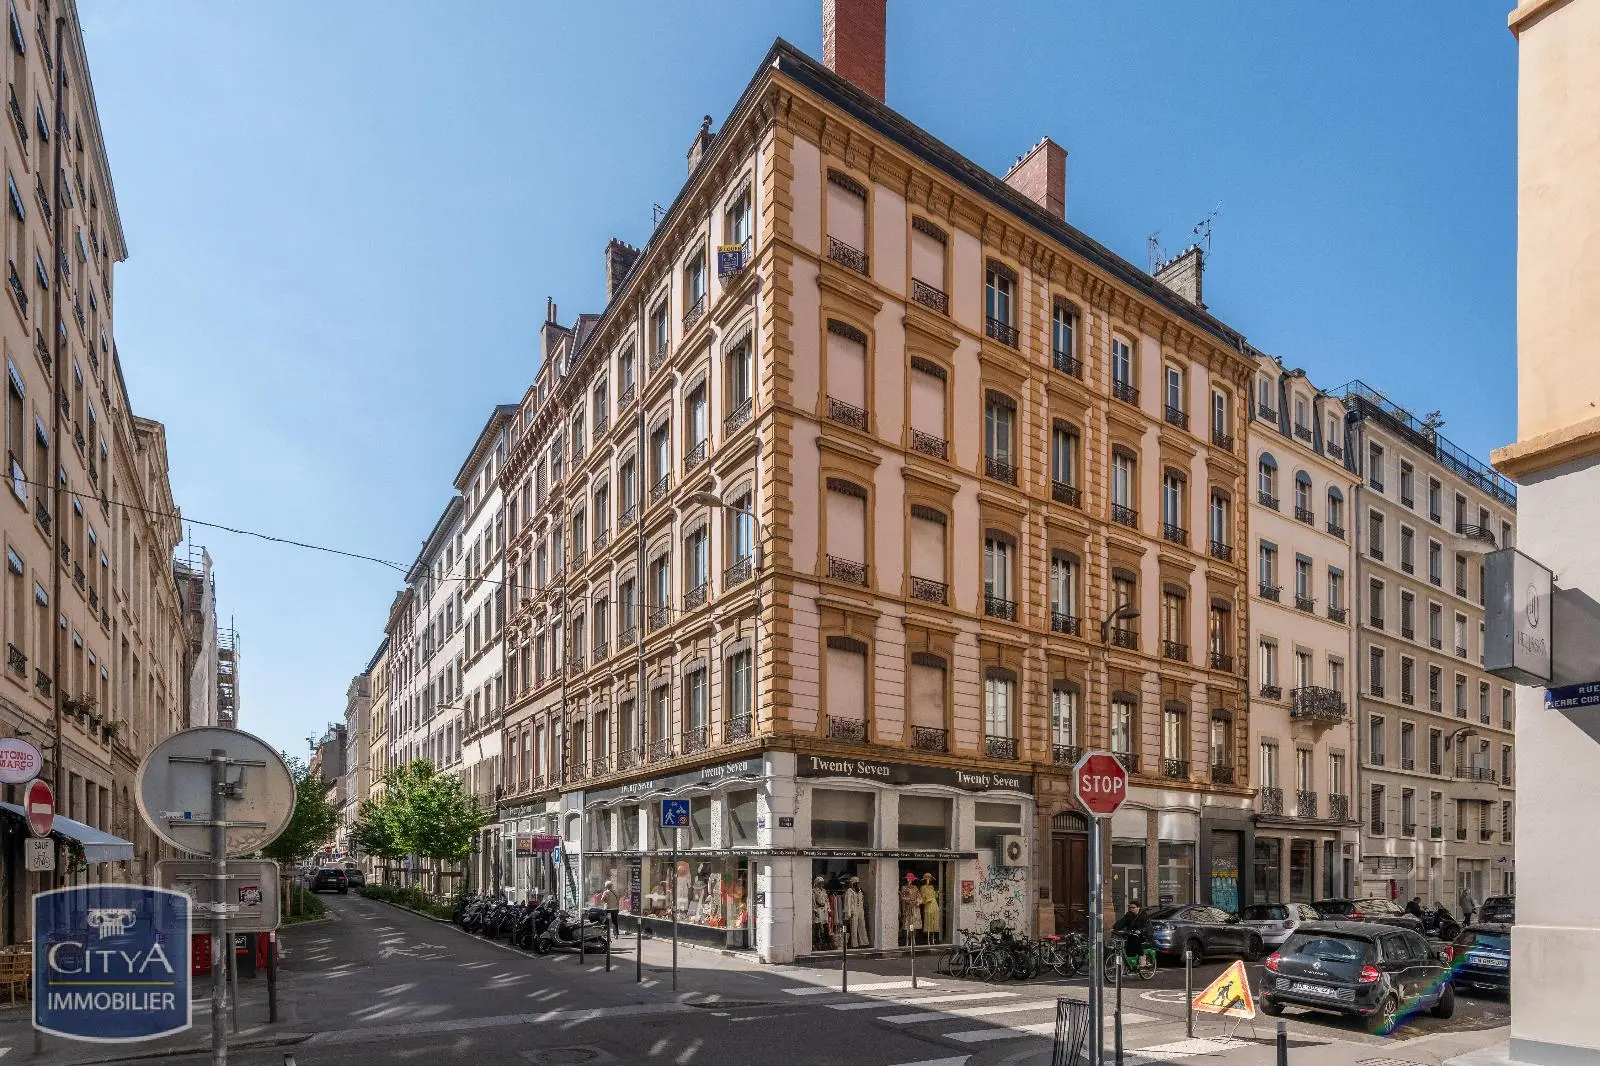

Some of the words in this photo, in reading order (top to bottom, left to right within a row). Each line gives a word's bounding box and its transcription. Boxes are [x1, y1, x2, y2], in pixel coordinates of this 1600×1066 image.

[1578, 684, 1600, 693] RUE
[701, 766, 725, 780] Twenty
[726, 761, 748, 774] Seven
[810, 756, 854, 774] Twenty
[857, 762, 890, 777] Seven
[955, 770, 991, 788] Twenty
[993, 774, 1020, 788] Seven
[1082, 774, 1123, 795] STOP
[34, 841, 49, 850] SAUF
